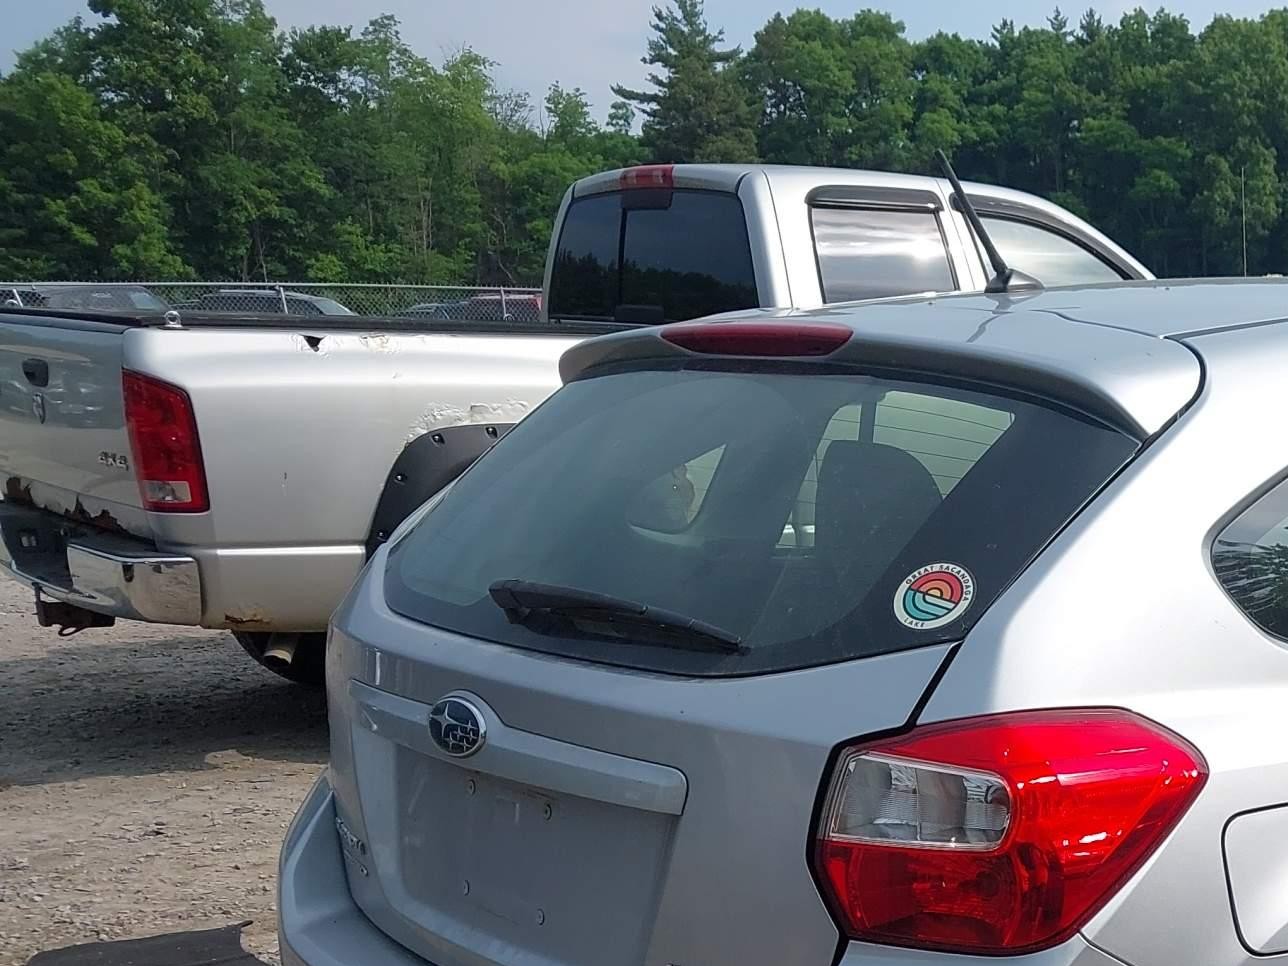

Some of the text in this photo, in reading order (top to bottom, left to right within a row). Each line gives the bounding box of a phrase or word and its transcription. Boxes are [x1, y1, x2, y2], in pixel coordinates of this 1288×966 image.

[905, 564, 973, 602] GREAT SACANDAGA
[903, 617, 926, 628] LAKE
